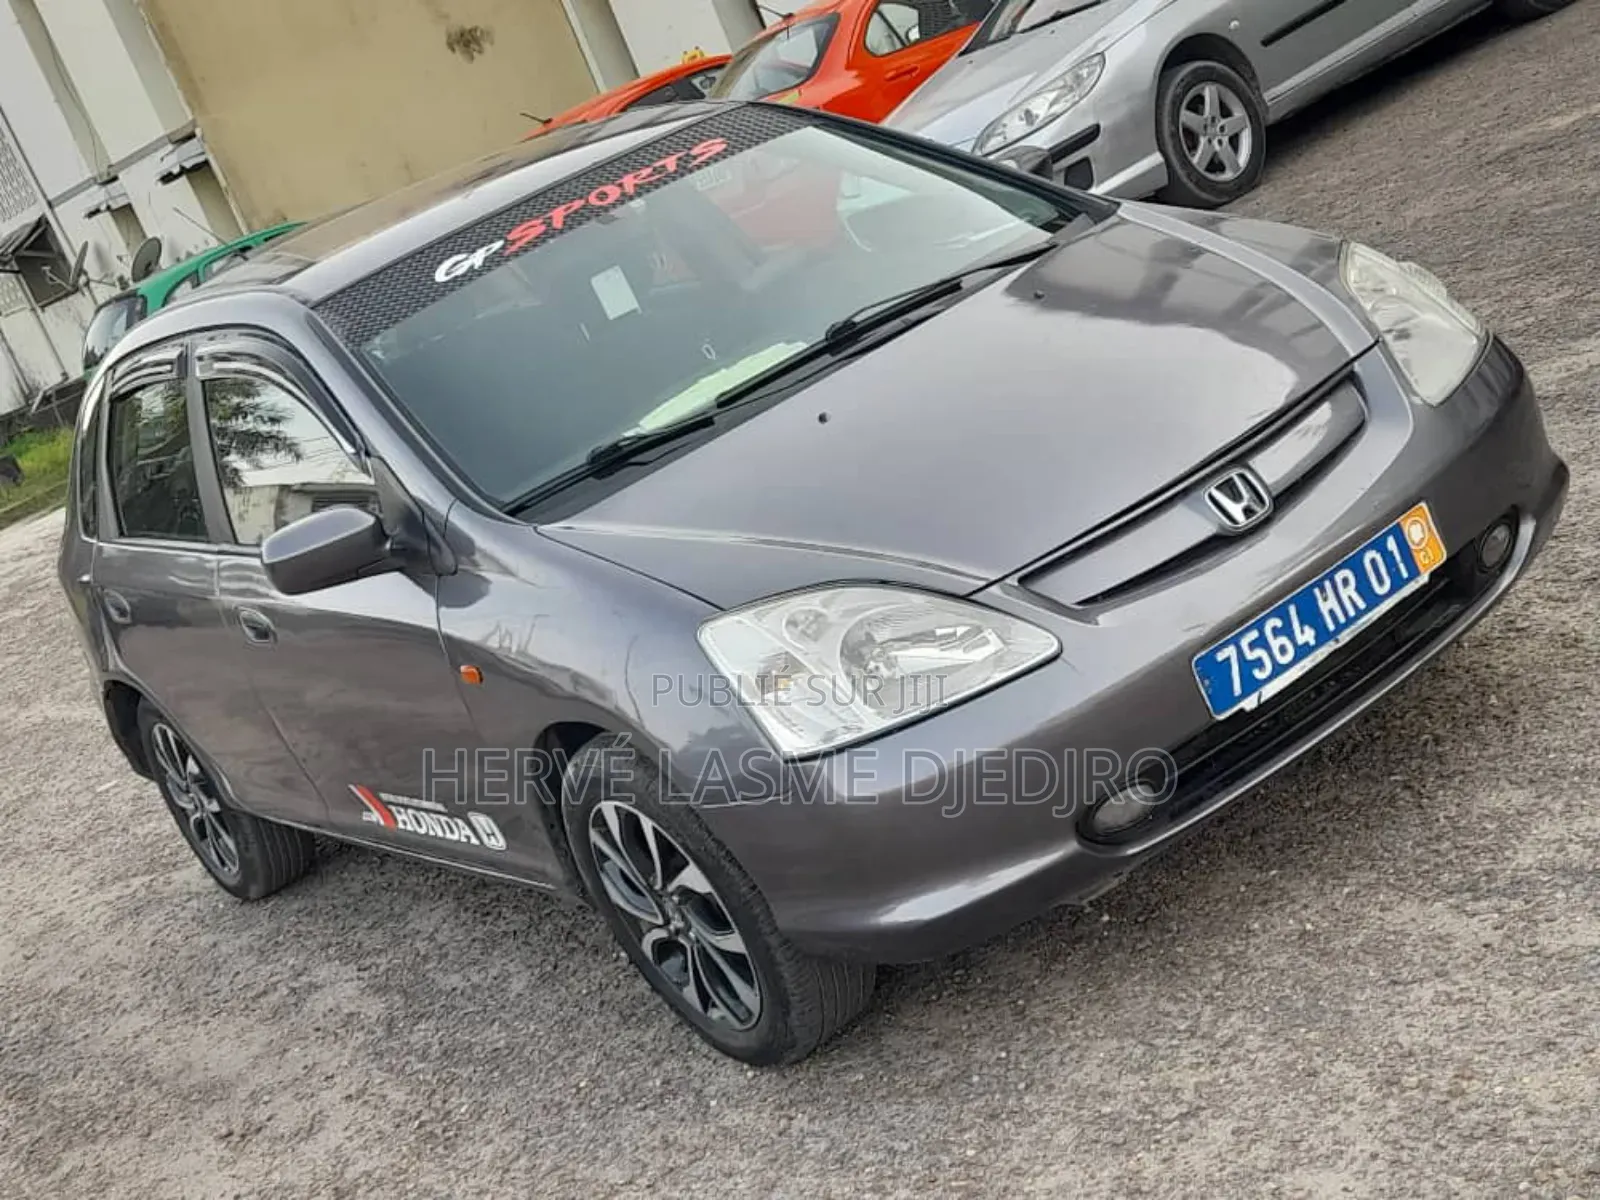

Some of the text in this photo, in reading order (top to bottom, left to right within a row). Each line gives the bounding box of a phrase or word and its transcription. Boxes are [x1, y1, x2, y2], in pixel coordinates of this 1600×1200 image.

[1216, 534, 1409, 697] 7564 HR 01
[389, 805, 481, 845] HONDA
